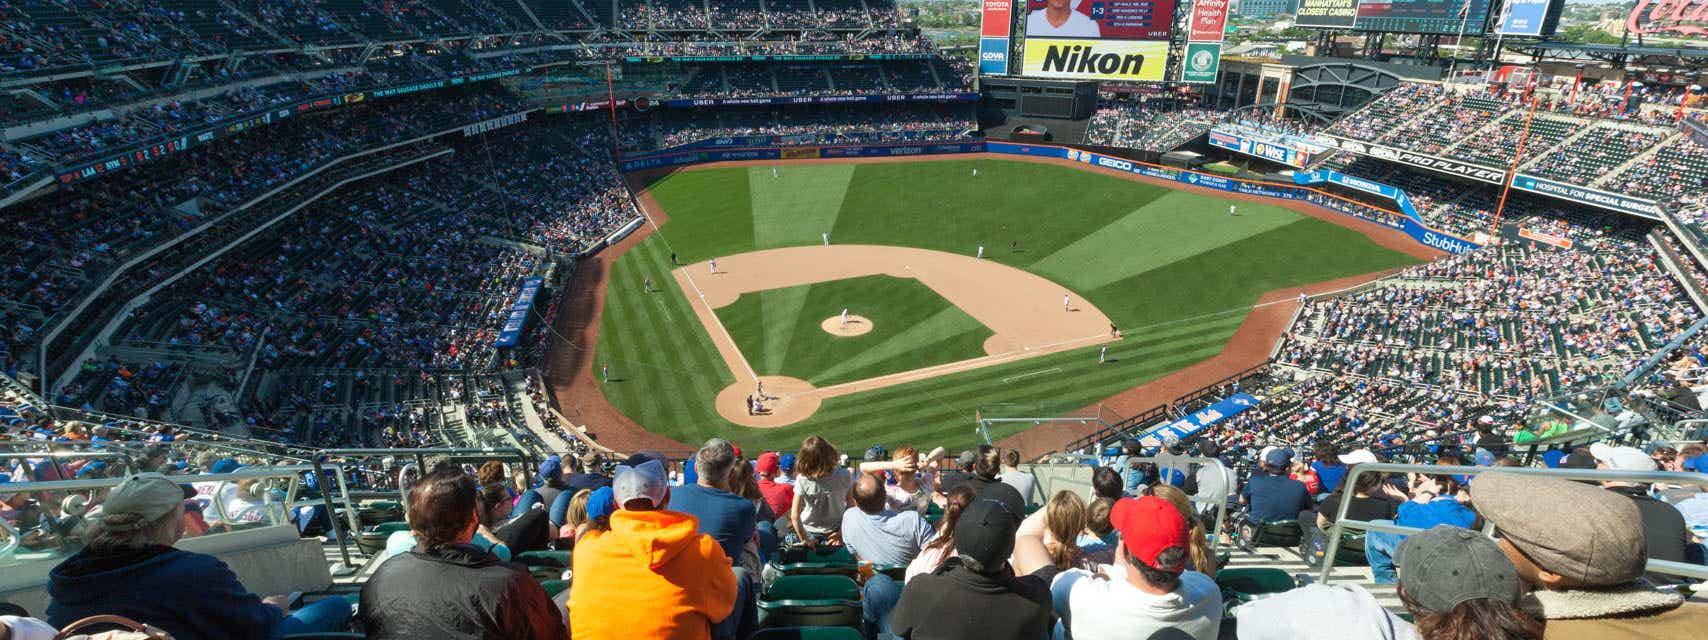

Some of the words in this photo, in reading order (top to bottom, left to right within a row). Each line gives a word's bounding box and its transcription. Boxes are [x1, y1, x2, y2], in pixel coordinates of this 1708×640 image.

[1298, 7, 1328, 16] CLOSEST
[1328, 8, 1356, 17] CASINO
[982, 52, 1004, 60] GOYA
[1041, 44, 1145, 75] Nikon
[890, 146, 922, 155] verizon
[1265, 145, 1286, 160] WISE
[1098, 157, 1132, 171] GEICO
[1400, 153, 1432, 166] PRO
[1433, 160, 1502, 181] PLAYER
[1350, 179, 1381, 192] HONDA
[1535, 182, 1569, 195] HOSPITAL
[1569, 189, 1585, 200] FOR
[1585, 191, 1620, 207] SPECIAL
